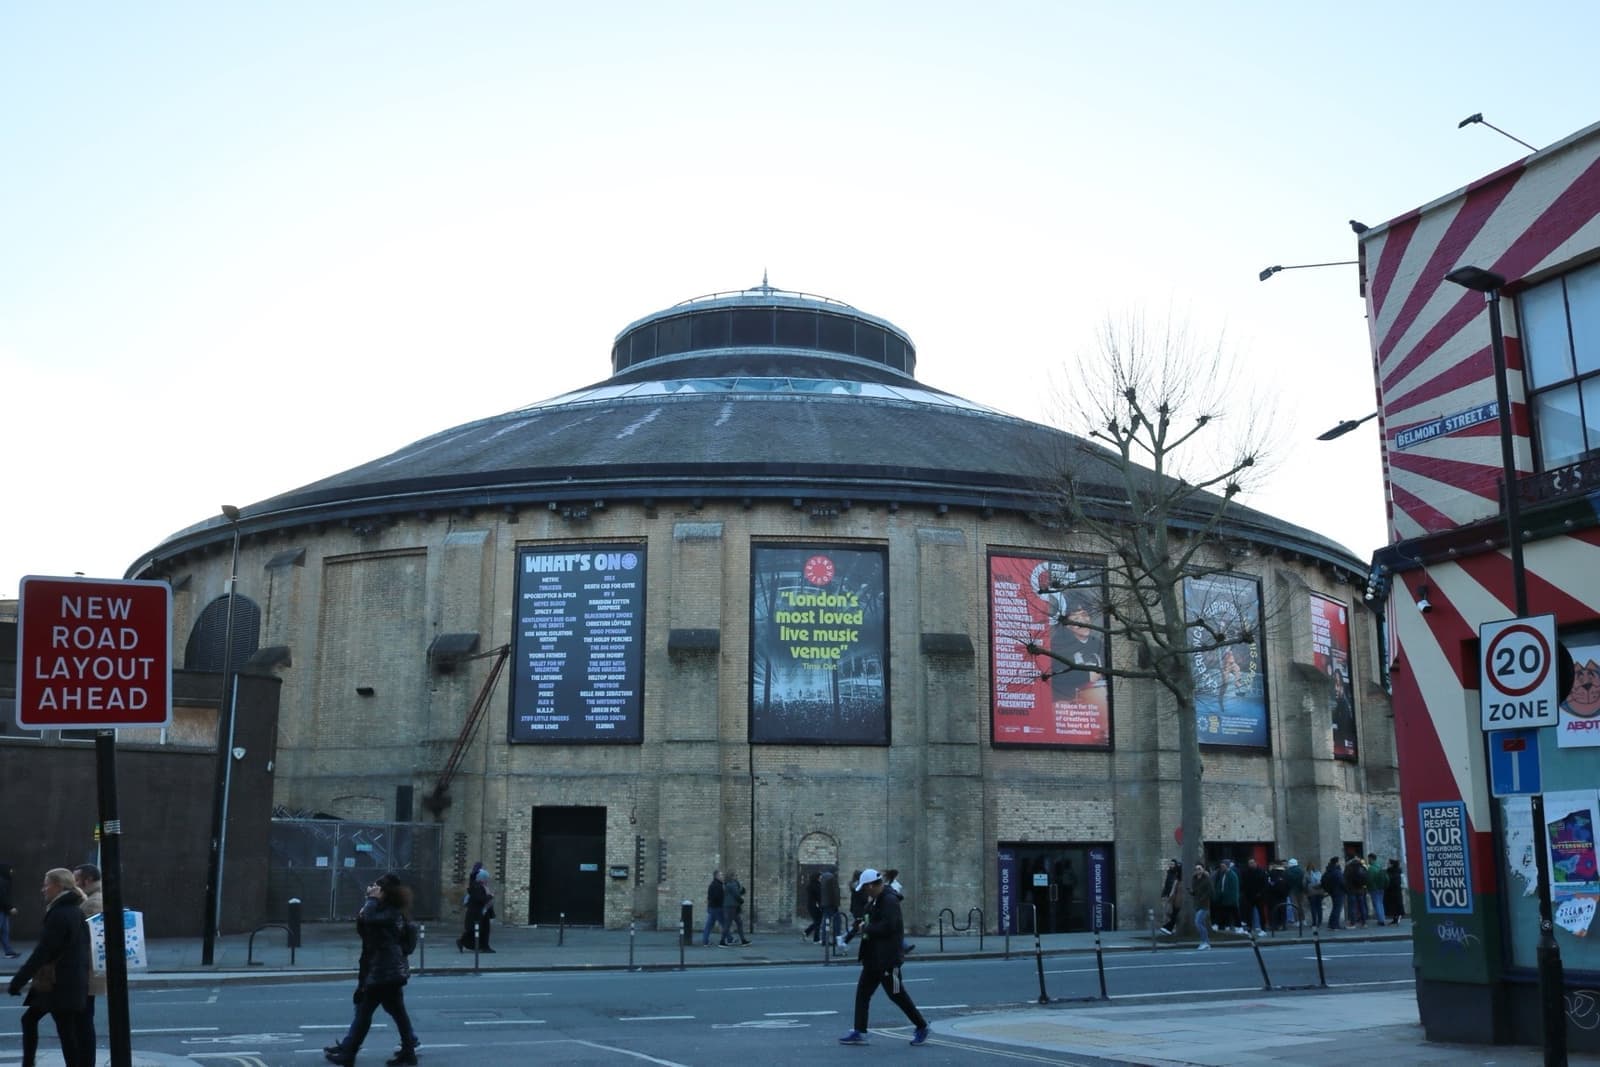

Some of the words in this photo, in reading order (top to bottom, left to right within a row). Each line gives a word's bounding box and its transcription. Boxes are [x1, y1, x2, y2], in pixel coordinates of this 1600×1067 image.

[1398, 422, 1441, 447] BELMONT
[526, 553, 591, 573] WHAT'S
[594, 553, 620, 571] ON
[60, 595, 133, 619] NEW
[776, 610, 815, 625] most
[819, 609, 863, 625] loved
[52, 626, 139, 650] ROAD
[780, 626, 809, 642] live
[813, 628, 859, 642] music
[35, 656, 155, 681] LAYOUT
[1496, 645, 1541, 676] 20
[38, 686, 148, 711] AHEAD
[1489, 700, 1549, 722] ZONE
[1423, 807, 1460, 819] PLEASE
[1424, 819, 1460, 829] RESPECT
[1426, 828, 1462, 845] OUR
[1438, 852, 1463, 860] COMING
[1429, 867, 1465, 877] QUIETLY!
[1002, 885, 1009, 893] TO
[1430, 878, 1466, 889] THANK
[1432, 889, 1467, 908] YOU
